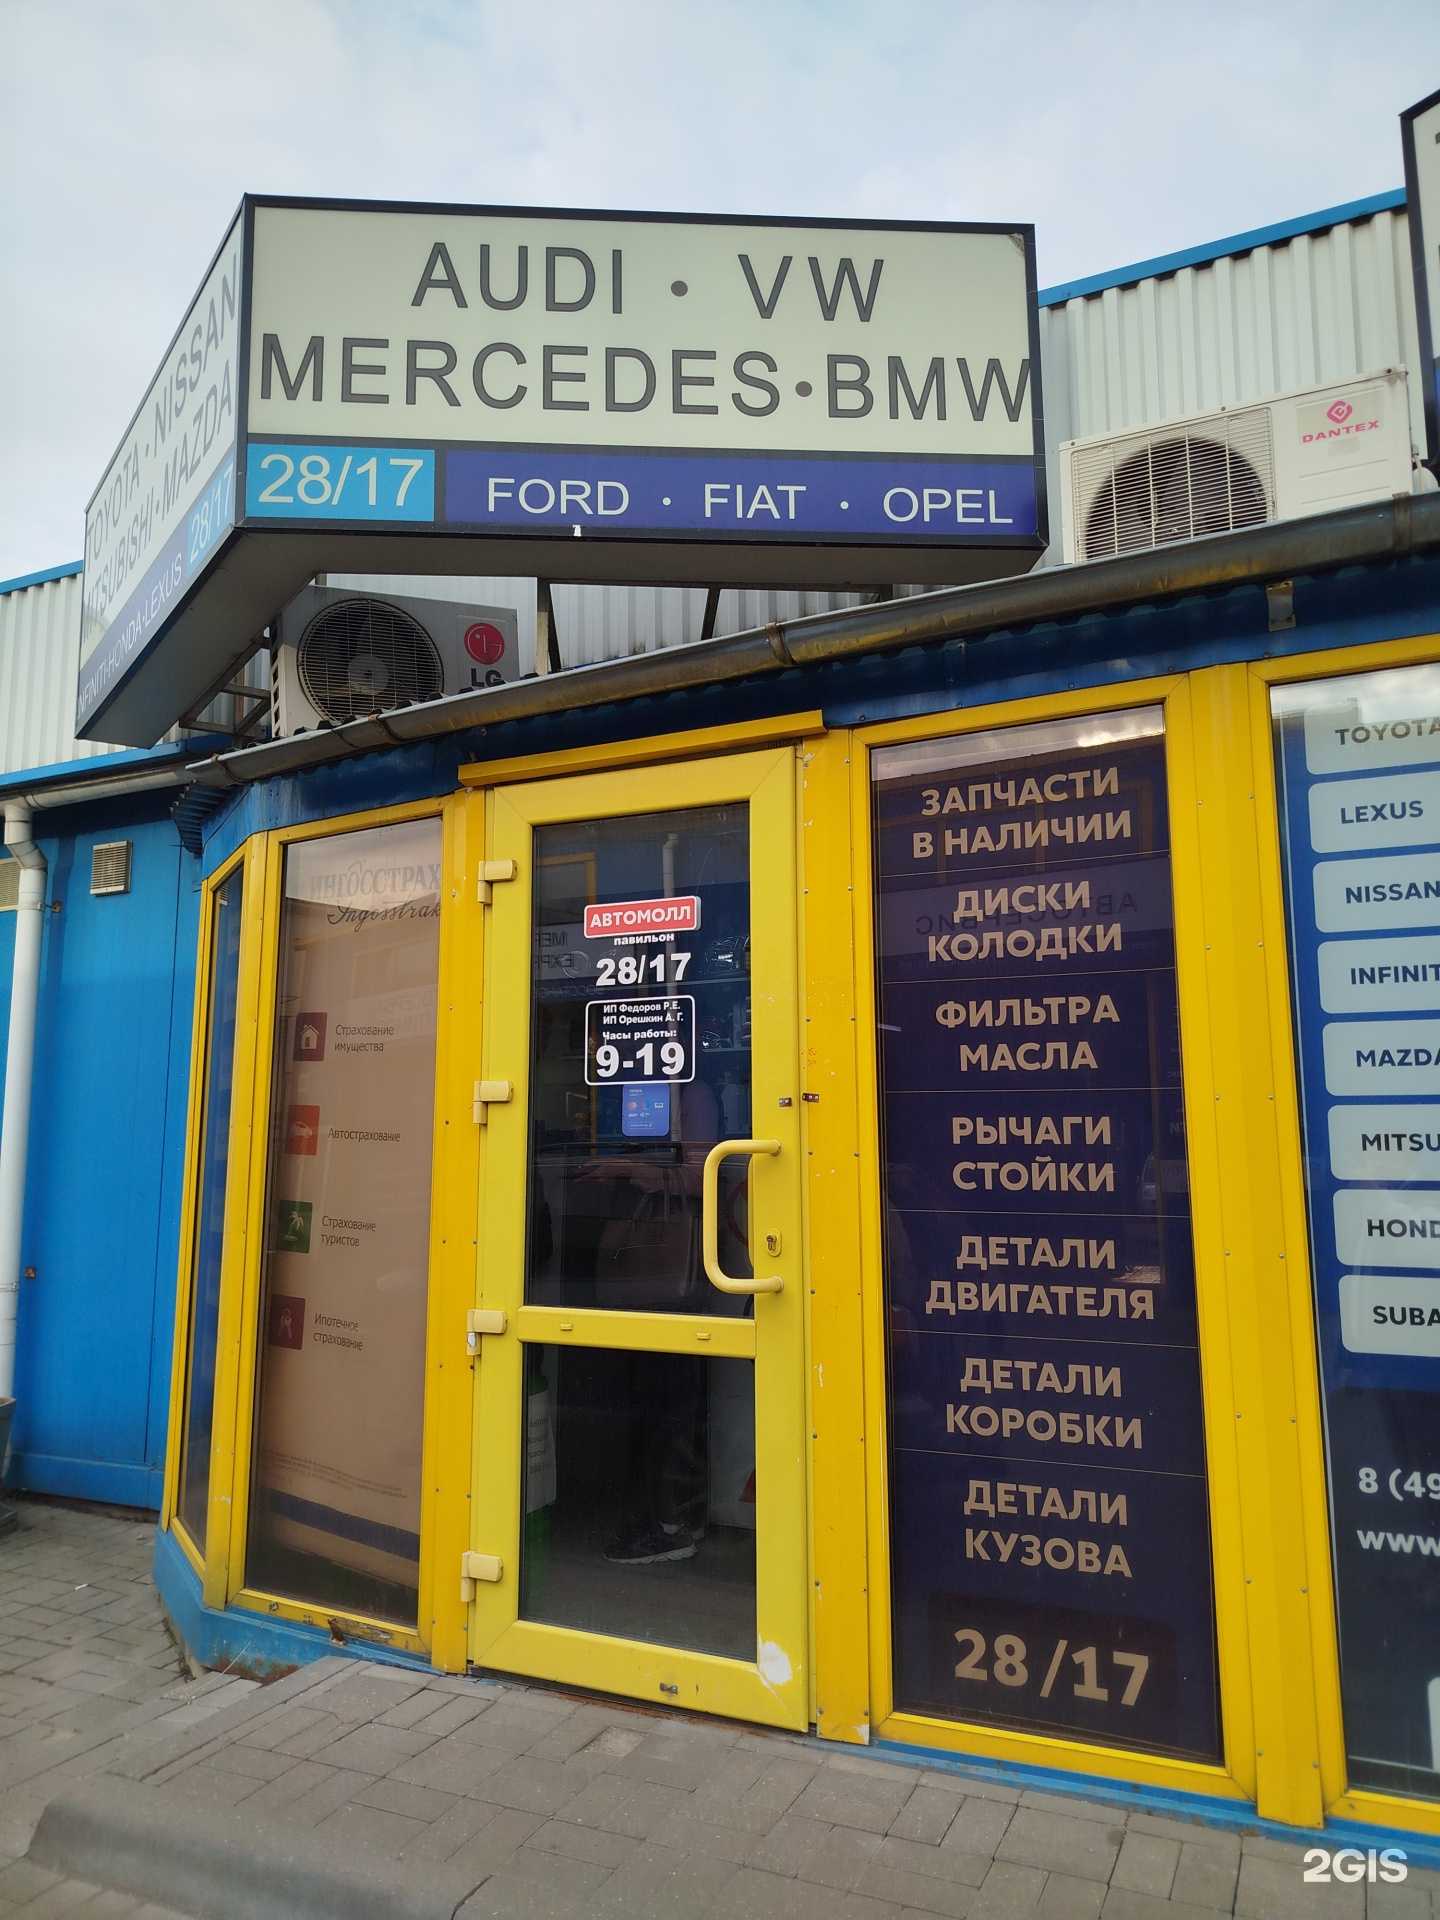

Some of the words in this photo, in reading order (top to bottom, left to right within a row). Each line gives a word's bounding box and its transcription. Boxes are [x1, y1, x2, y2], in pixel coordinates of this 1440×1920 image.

[410, 242, 624, 315] AUDI
[738, 254, 886, 324] VW
[87, 443, 140, 568] TOYOTA
[154, 253, 236, 458] NISSAN
[1302, 419, 1380, 444] DANTEX
[257, 453, 425, 507] 28/17
[190, 462, 235, 564] 28/17
[487, 477, 630, 517] FORD
[703, 483, 808, 521] FIAT
[882, 487, 1014, 525] OPEL
[470, 667, 506, 688] LG
[1334, 716, 1440, 746] TOYOTA
[920, 766, 1121, 816] ЗАПЧАСТИ
[1340, 799, 1425, 825] LEXUS
[912, 832, 934, 859] В
[944, 809, 1132, 857] НАЛИЧИИ
[953, 880, 1091, 923] ДИСКИ
[1345, 880, 1440, 905] NISSAN
[589, 905, 691, 929] АВТОМОЛЛ
[613, 932, 675, 946] павильон
[928, 923, 1123, 962] КОЛОДКИ
[595, 952, 692, 987] 28/17
[1350, 963, 1440, 986] INFINIT
[602, 1015, 617, 1025] ИП
[618, 1014, 663, 1026] Орешкин
[603, 1004, 617, 1014] ИП
[618, 1003, 662, 1013] Федоров
[935, 994, 1121, 1030] ФИЛЬТРА
[335, 1024, 395, 1037] Страхование
[602, 1031, 632, 1040] Часы
[633, 1029, 677, 1041] работы:
[334, 1042, 384, 1054] имущества
[595, 1041, 686, 1078] 9-19
[959, 1041, 1099, 1072] МАСЛА
[327, 1126, 401, 1143] Автострахование
[951, 1116, 1112, 1145] РЫЧАГИ
[1361, 1133, 1440, 1152] MITSU
[951, 1155, 1116, 1192] СТОЙКИ
[320, 1214, 377, 1233] Страхование
[320, 1232, 360, 1248] туристов
[956, 1235, 1117, 1270] ДЕТАЛИ
[925, 1280, 1155, 1320] ДВИГАТЕЛЯ
[314, 1312, 359, 1331] Ипотечное
[1373, 1305, 1440, 1327] SUBA
[312, 1330, 364, 1351] страхование
[960, 1358, 1123, 1398] ДЕТАЛИ
[945, 1403, 1143, 1449] КОРОБКИ
[1358, 1467, 1379, 1494] 8
[963, 1479, 1128, 1527] ДЕТАЛИ
[964, 1528, 1133, 1578] КУЗОВА
[1356, 1529, 1440, 1558] www
